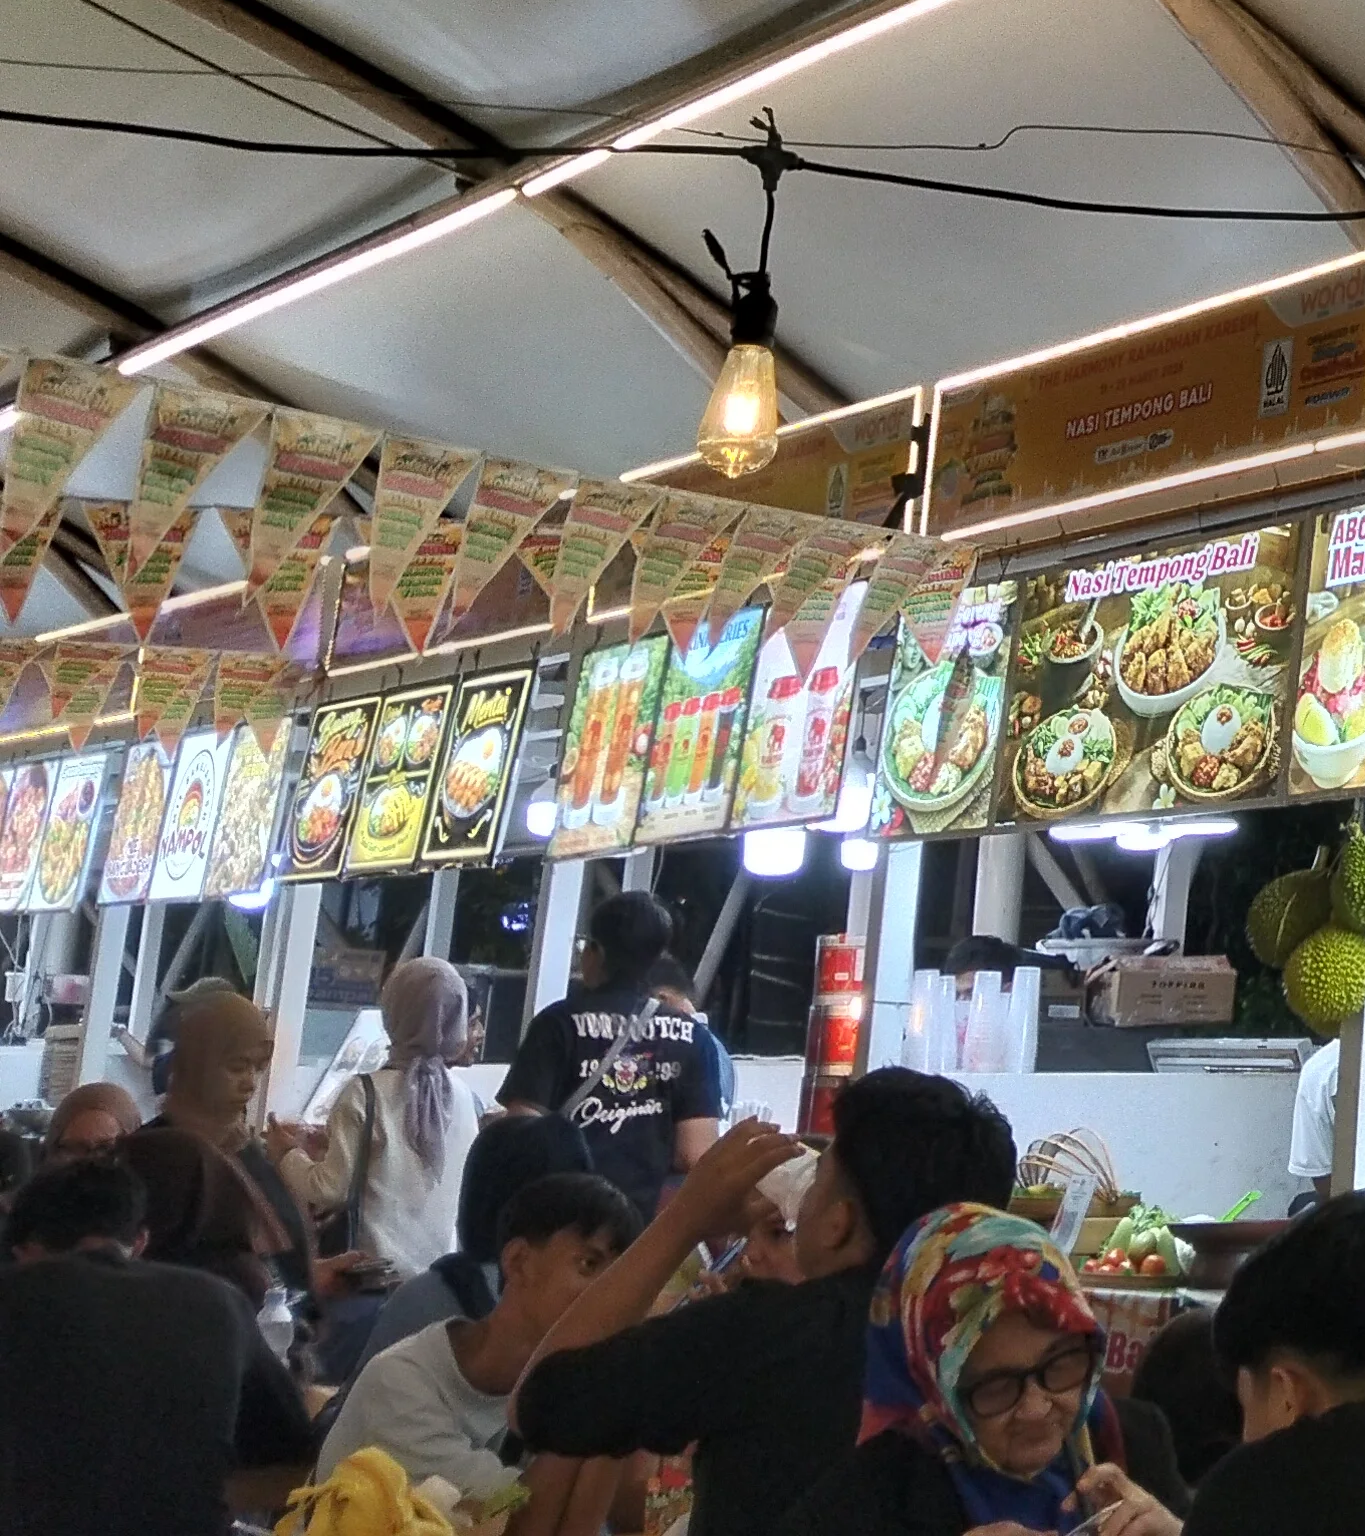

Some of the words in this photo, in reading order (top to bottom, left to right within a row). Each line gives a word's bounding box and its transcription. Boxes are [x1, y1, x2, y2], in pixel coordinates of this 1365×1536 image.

[1065, 412, 1100, 439] NASI
[1102, 393, 1174, 429] TEMPONG
[1178, 382, 1214, 409] BALI
[1071, 563, 1111, 597] Nasi
[1115, 550, 1210, 589] Tempong
[1210, 537, 1258, 572] Bali
[460, 686, 514, 734] Mentai
[158, 825, 207, 863] NAMPOL
